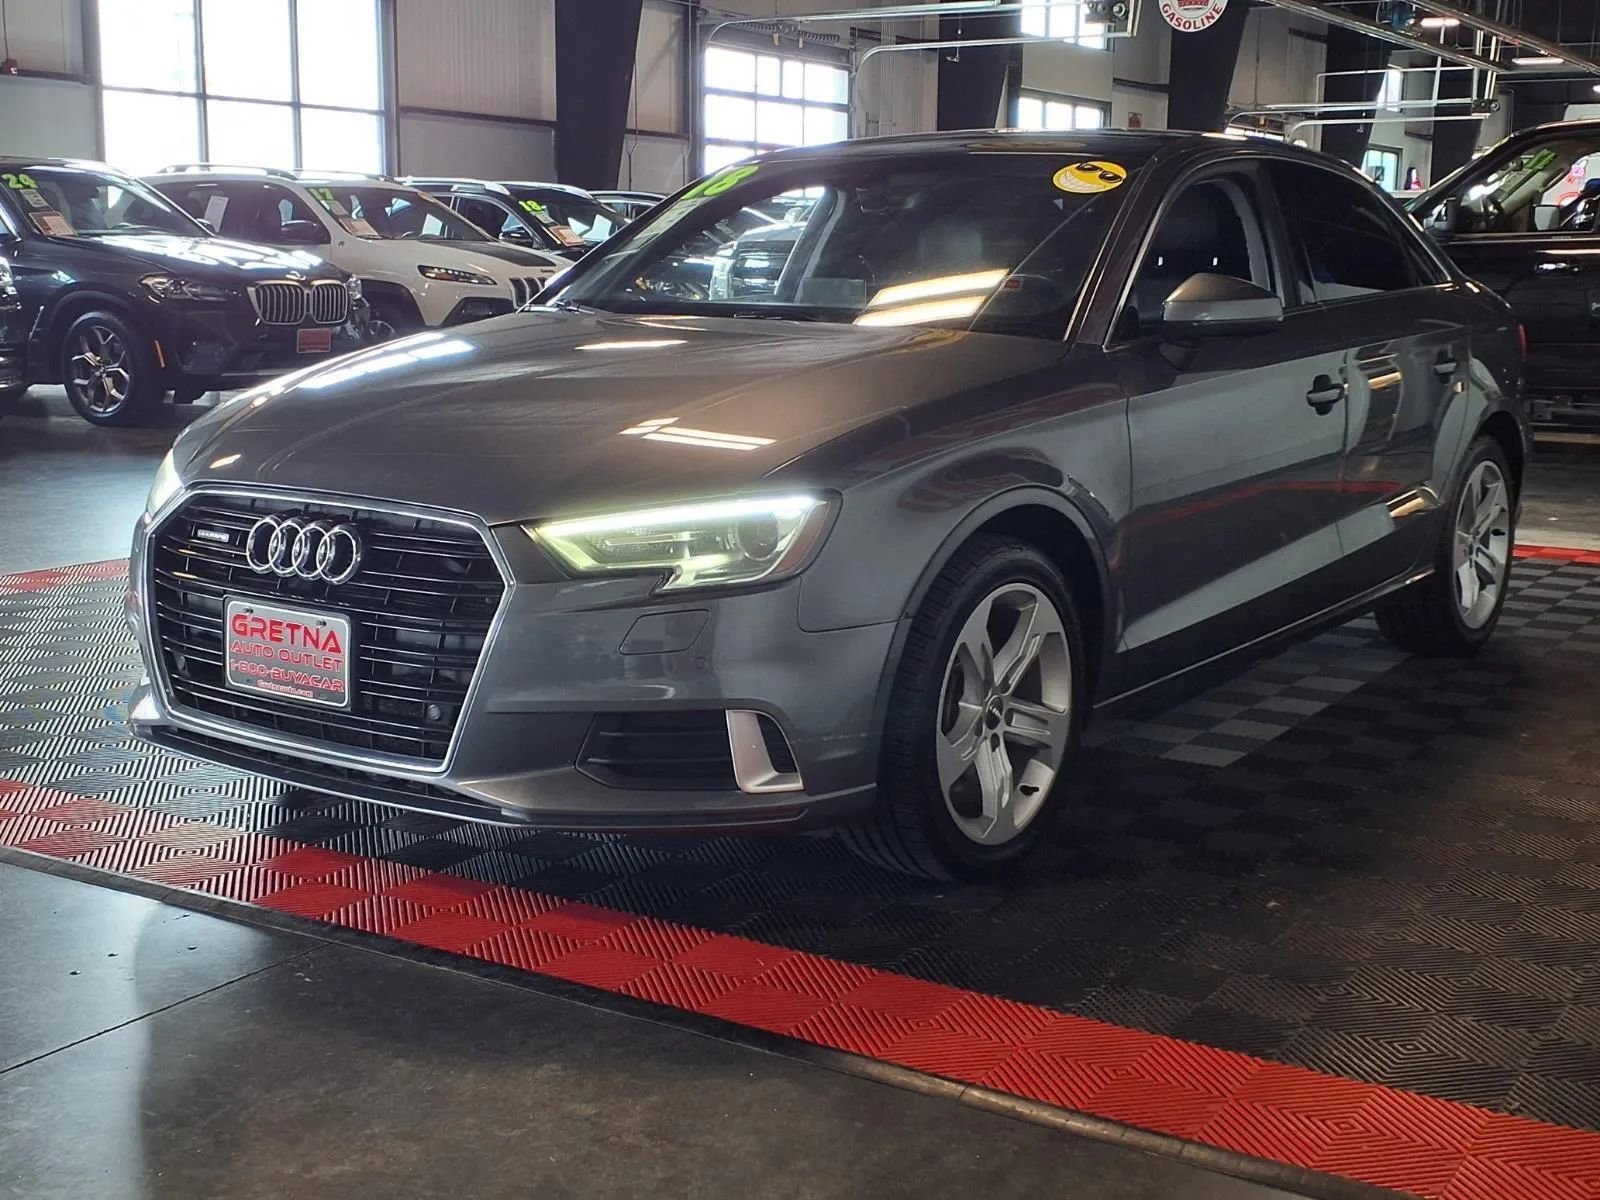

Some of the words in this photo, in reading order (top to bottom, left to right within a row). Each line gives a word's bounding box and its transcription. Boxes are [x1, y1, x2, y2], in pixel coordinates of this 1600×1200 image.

[1162, 3, 1223, 30] GASOLINE
[1, 173, 39, 190] 24
[231, 613, 342, 654] GRETNA
[231, 640, 273, 660] AUTO
[279, 649, 343, 672] OUTLET
[230, 659, 344, 692] 1-800-BUYACAR
